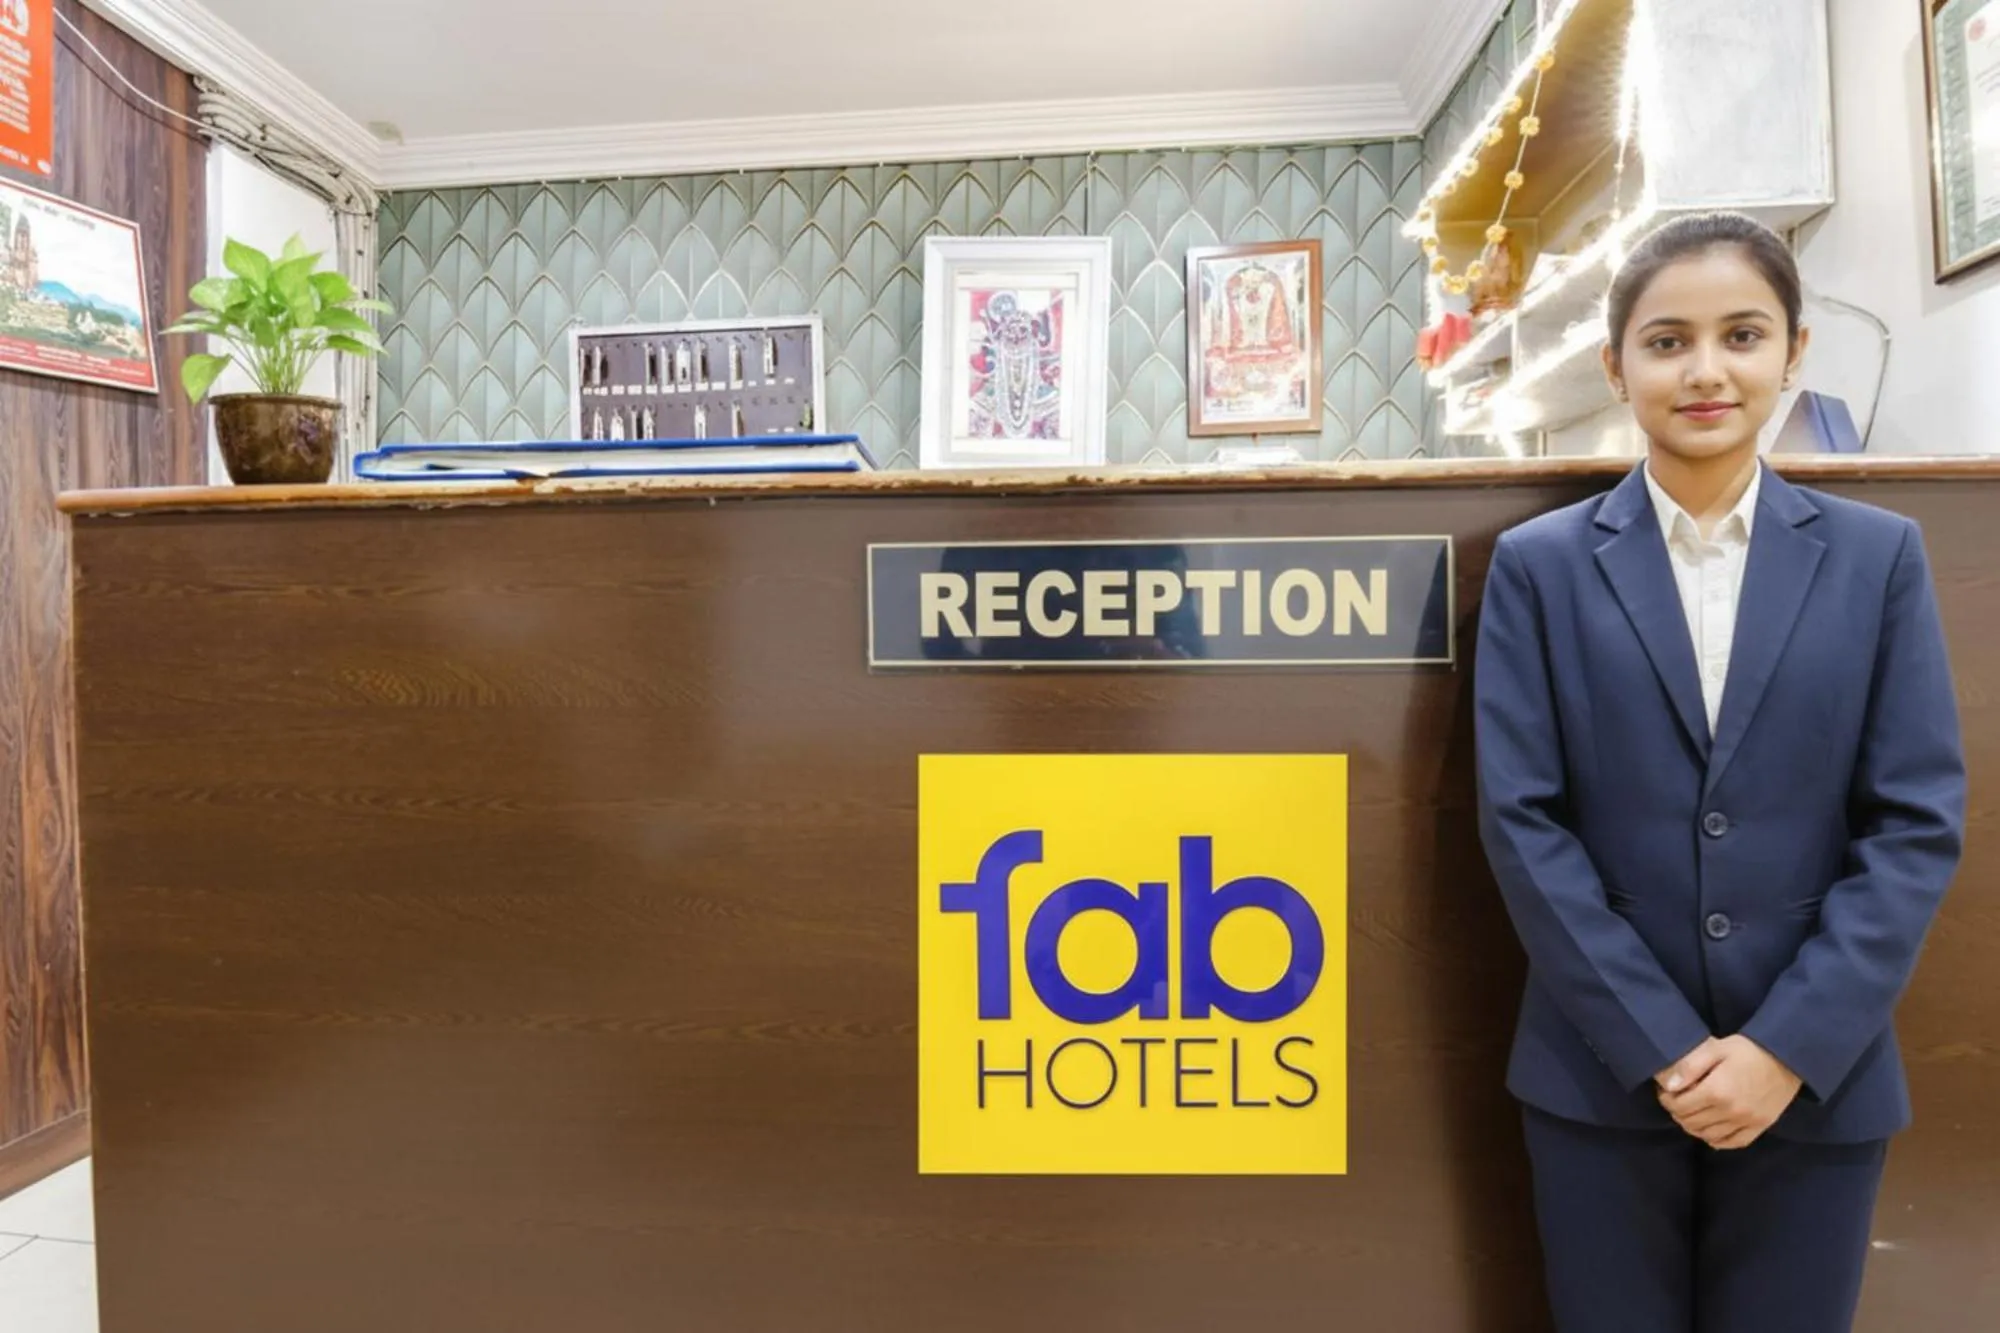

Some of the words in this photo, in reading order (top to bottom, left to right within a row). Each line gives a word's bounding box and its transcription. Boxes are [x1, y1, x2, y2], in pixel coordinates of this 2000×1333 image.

[920, 568, 1388, 638] RECEPTION
[939, 830, 1325, 1025] fab
[977, 1037, 1319, 1109] HOTELS
